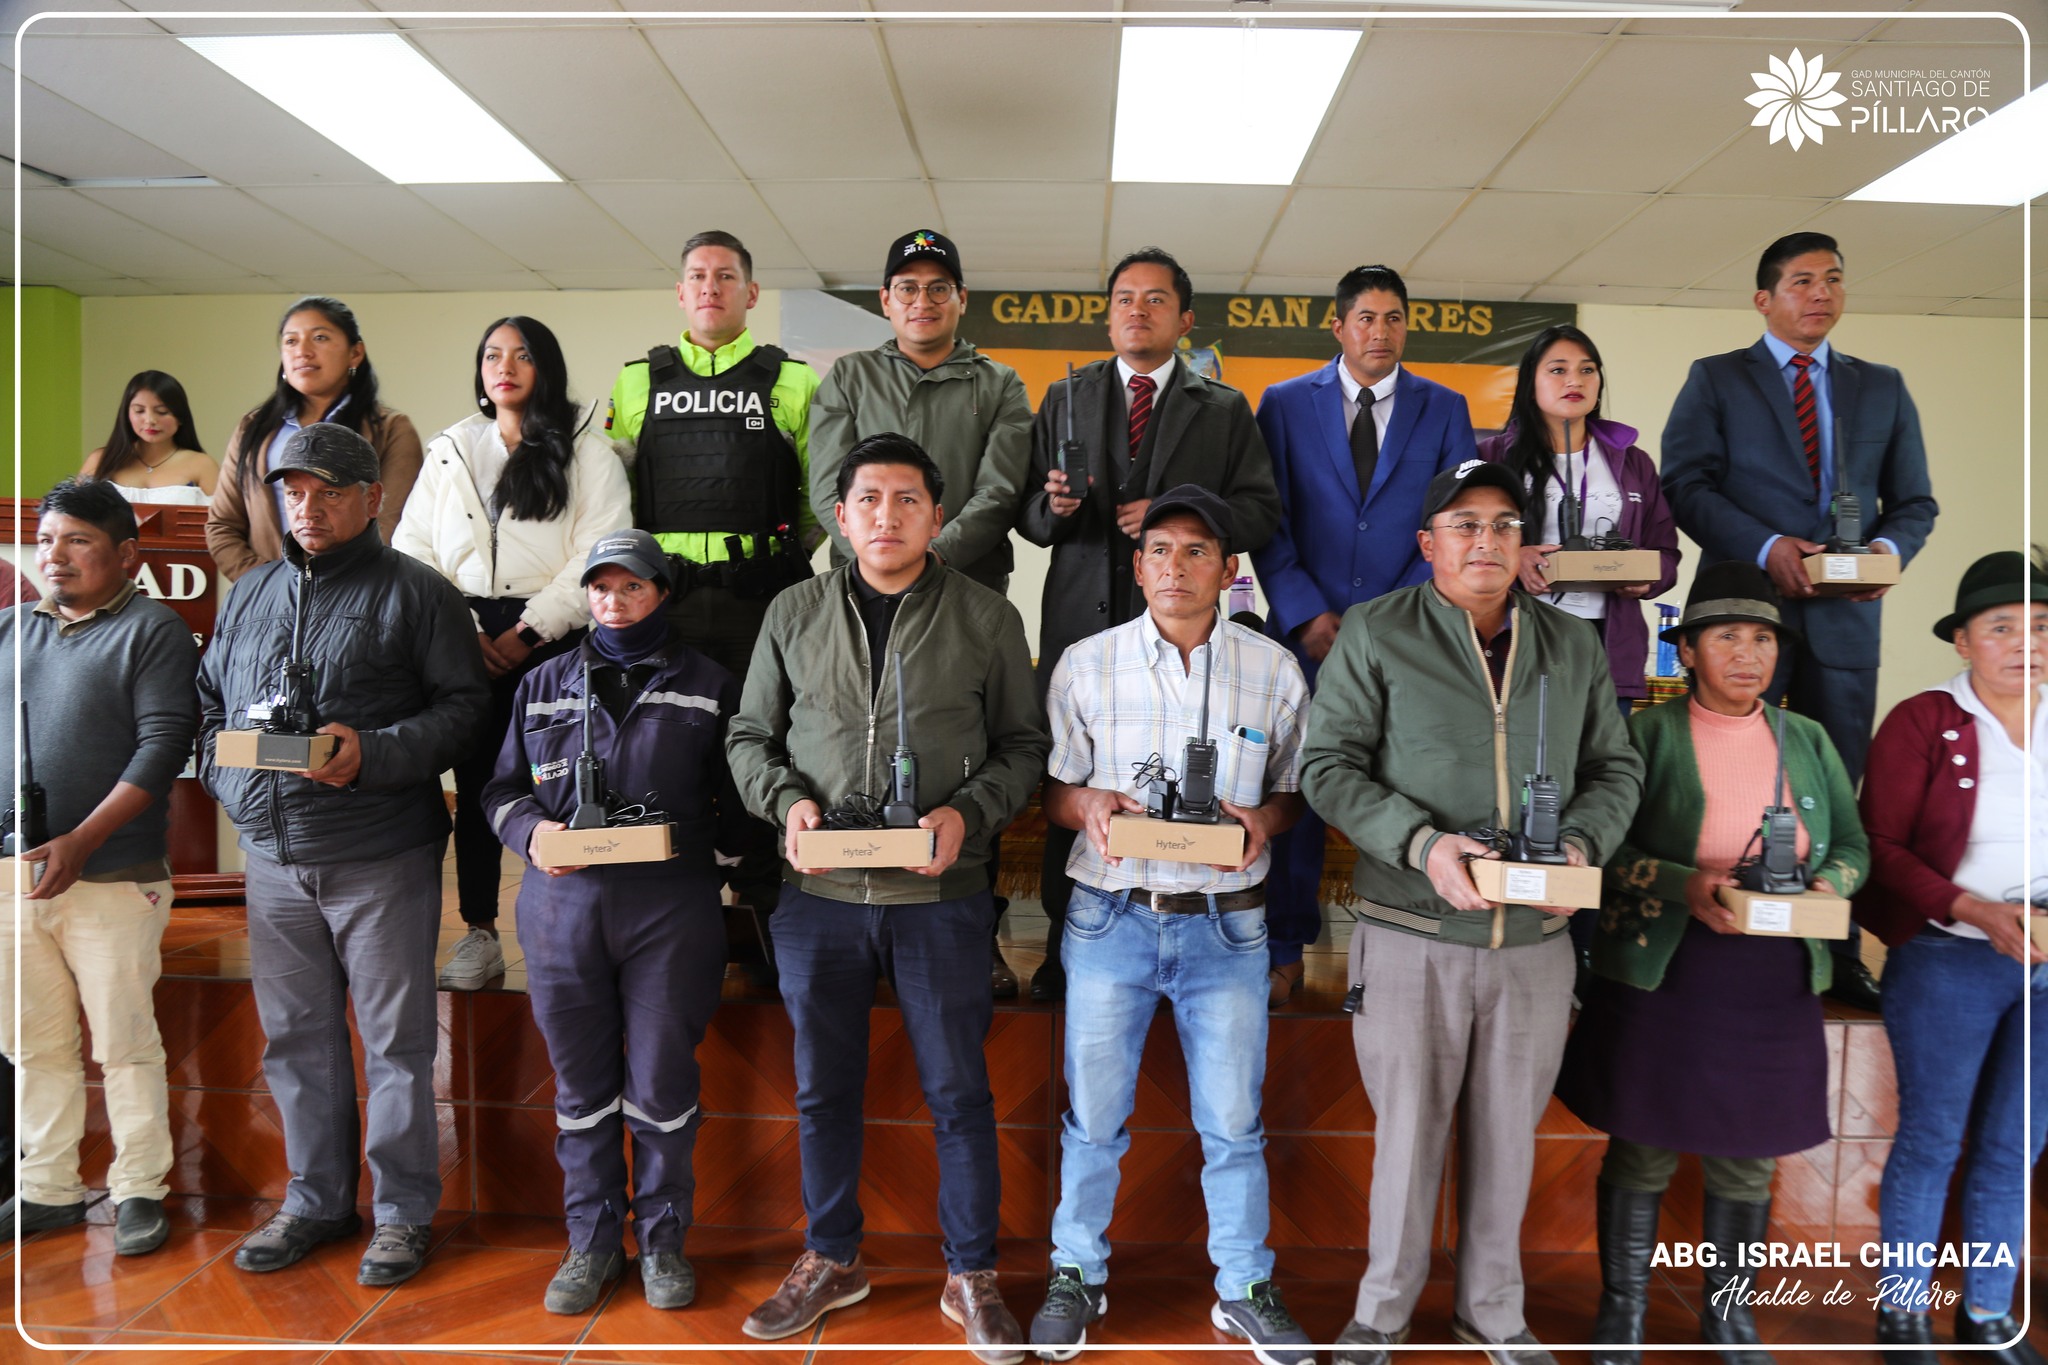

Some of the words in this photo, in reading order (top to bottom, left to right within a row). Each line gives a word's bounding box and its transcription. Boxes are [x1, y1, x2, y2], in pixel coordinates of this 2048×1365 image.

[991, 293, 1110, 324] GADP
[1228, 297, 1312, 328] SAN
[1319, 301, 1493, 336] ARES
[654, 390, 764, 415] POLICIA
[133, 562, 207, 600] AD
[583, 844, 613, 855] Hytera
[842, 847, 873, 858] Hytera
[1155, 839, 1187, 851] Hytera
